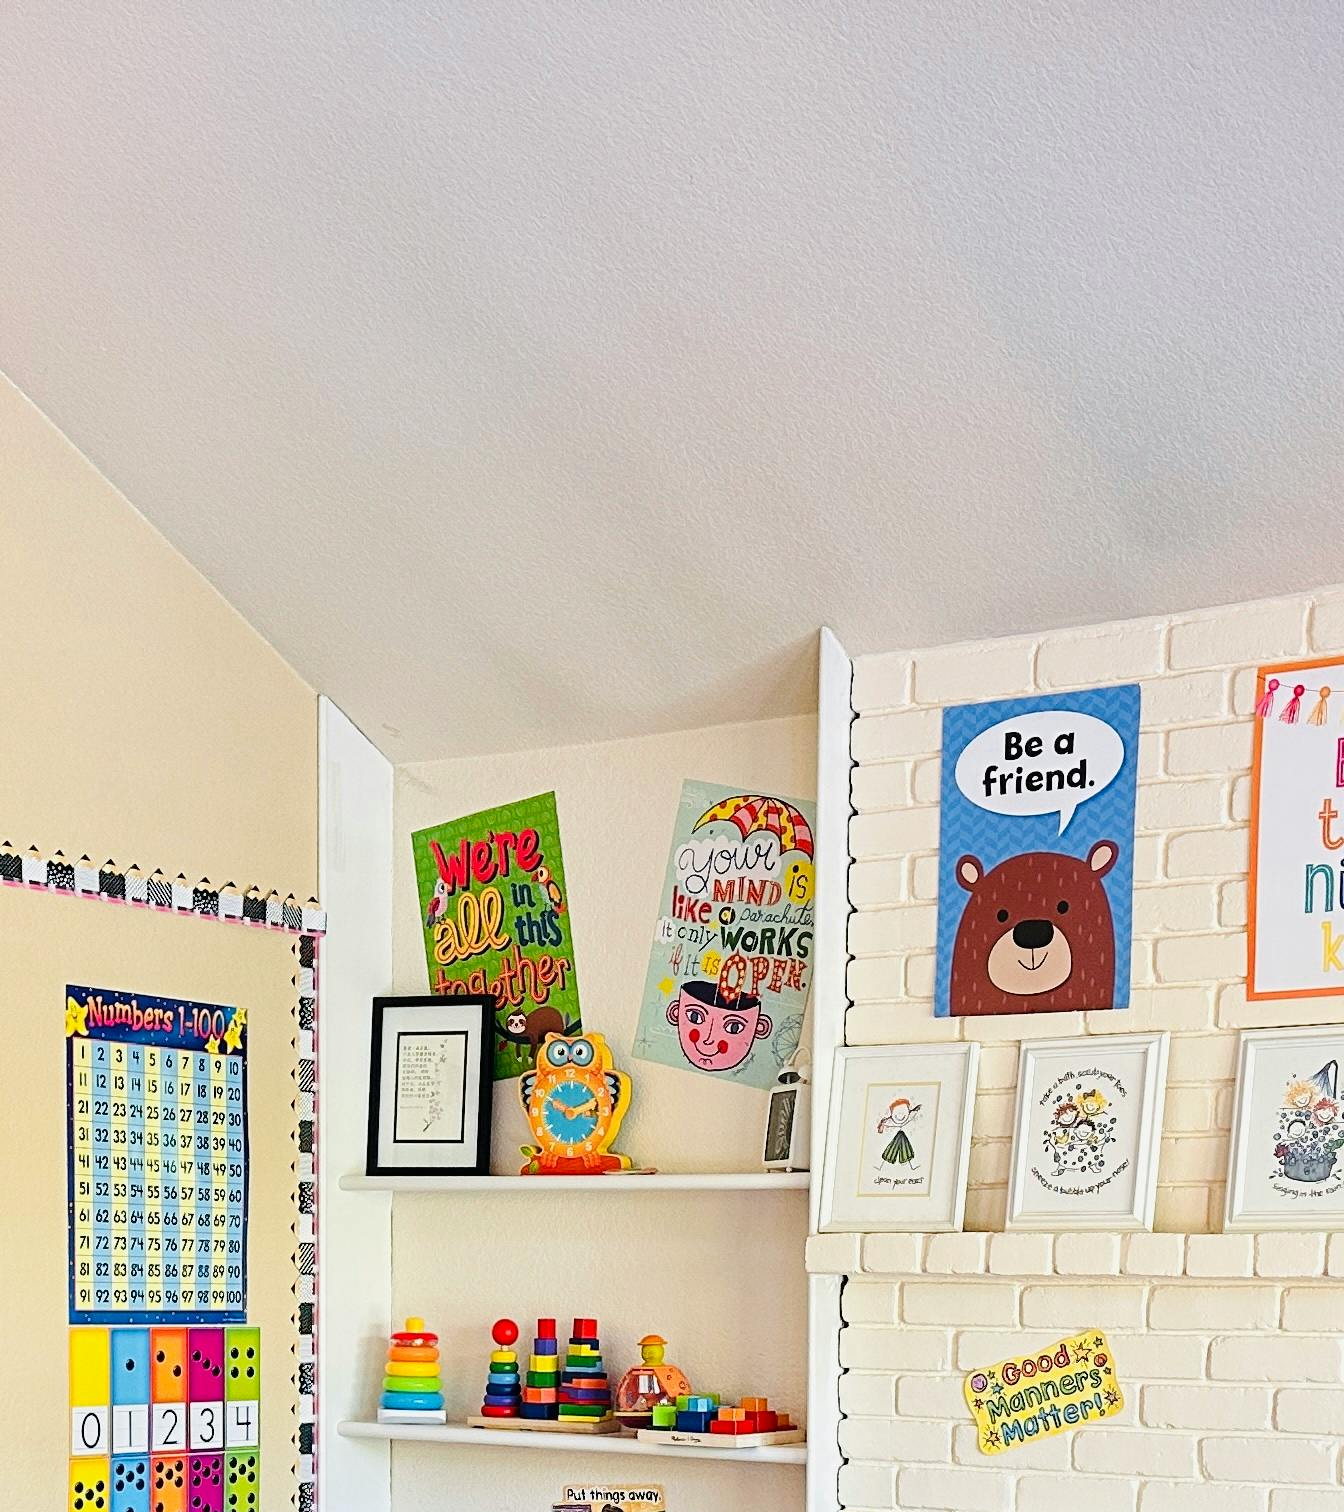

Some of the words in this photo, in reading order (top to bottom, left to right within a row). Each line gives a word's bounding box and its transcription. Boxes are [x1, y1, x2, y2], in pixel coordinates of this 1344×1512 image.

[1004, 731, 1043, 761] Be
[1054, 732, 1075, 755] a
[983, 758, 1095, 797] friend.
[430, 828, 543, 895] We're
[672, 885, 713, 924] like
[718, 906, 736, 925] a
[712, 876, 782, 906] MIND
[788, 865, 808, 899] is
[434, 887, 511, 965] all
[511, 883, 536, 908] in
[515, 910, 562, 947] this
[677, 925, 718, 952] only
[720, 926, 814, 959] WORKS
[669, 943, 683, 977] if
[720, 949, 808, 1003] OPEN.
[87, 995, 174, 1033] Numbers
[178, 1006, 225, 1040] 1-100
[1002, 1344, 1071, 1386] Good
[986, 1368, 1102, 1424] Manners
[1001, 1393, 1106, 1447] Matter!
[567, 1488, 586, 1500] Put
[589, 1488, 625, 1504] things
[628, 1490, 662, 1503] away.
